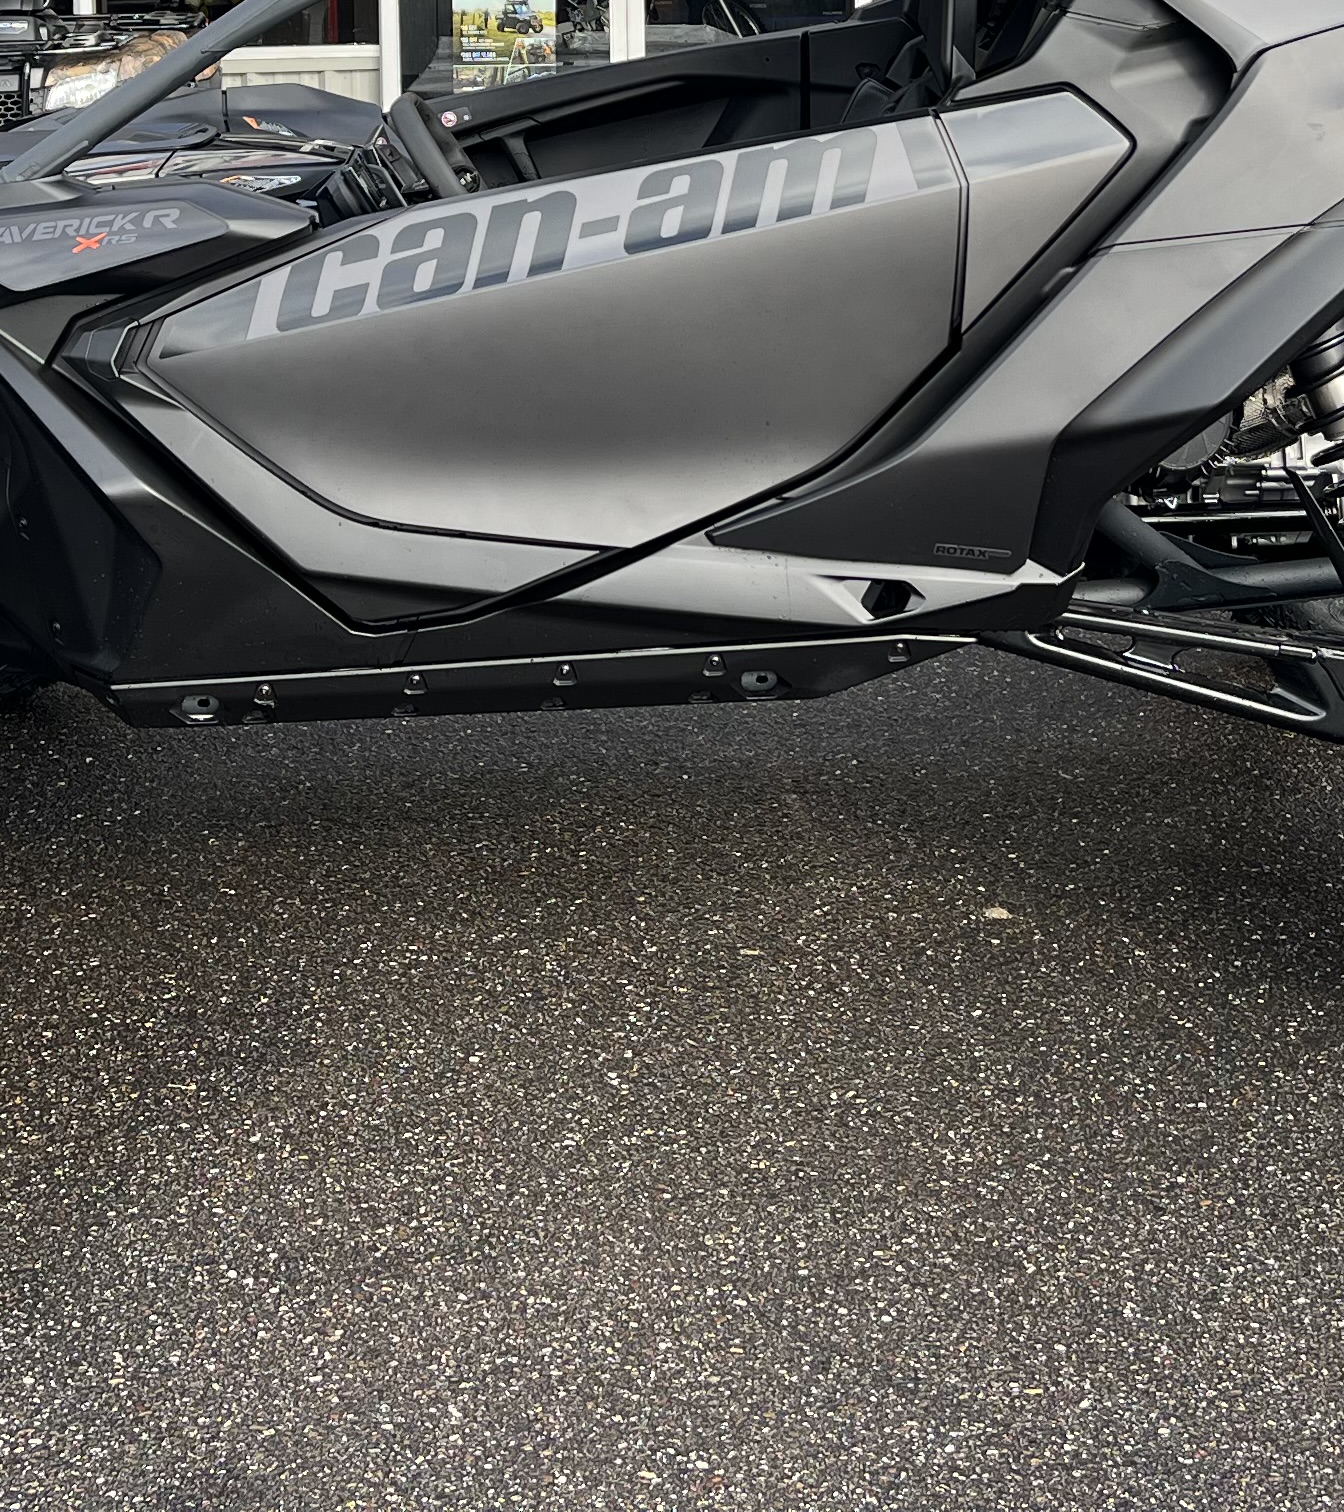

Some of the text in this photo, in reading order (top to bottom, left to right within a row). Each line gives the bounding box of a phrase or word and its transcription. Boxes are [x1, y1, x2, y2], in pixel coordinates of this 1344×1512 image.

[142, 208, 181, 229] R
[274, 120, 880, 336] can-am
[935, 544, 990, 560] ROTAX
